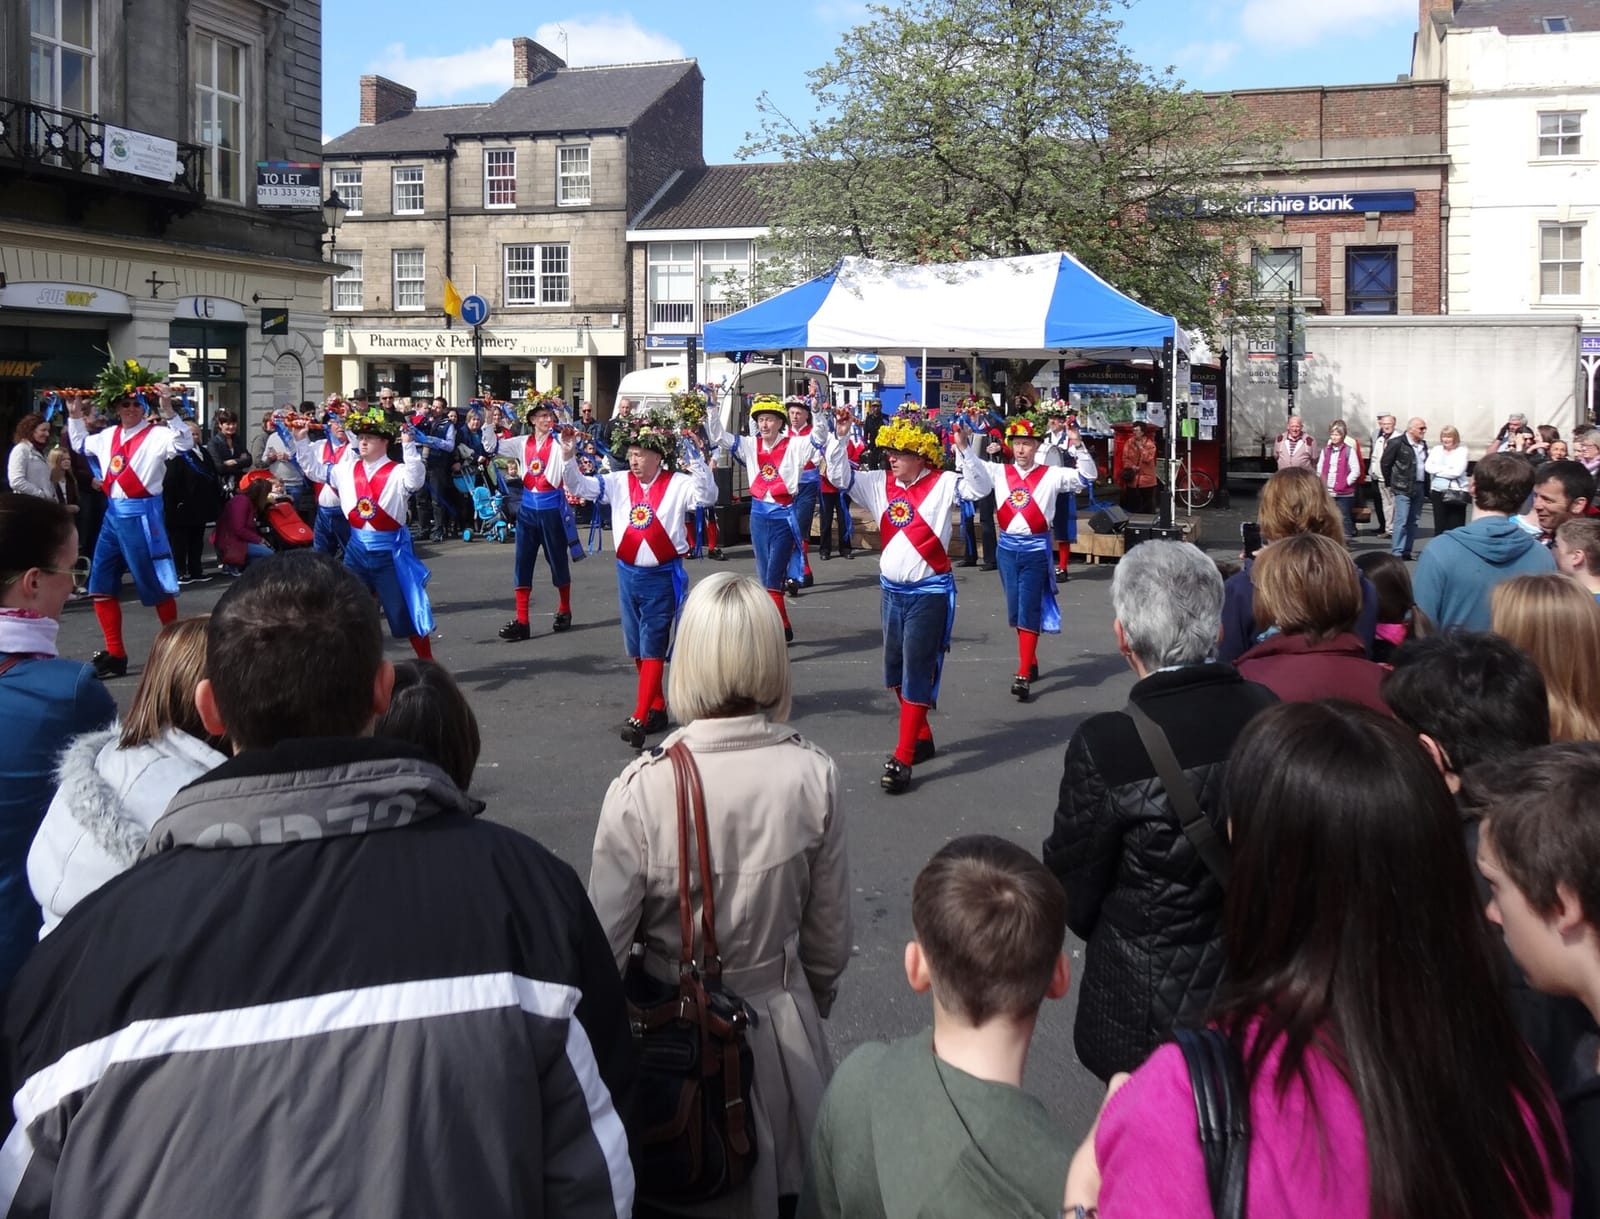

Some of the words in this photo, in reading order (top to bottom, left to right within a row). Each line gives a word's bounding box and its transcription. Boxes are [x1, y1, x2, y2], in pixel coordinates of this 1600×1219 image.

[263, 173, 279, 185] TO
[282, 173, 302, 185] LET
[257, 187, 279, 196] 0113
[281, 188, 298, 197] 333
[1308, 195, 1355, 212] Bank
[36, 287, 98, 306] SUBWAY
[369, 333, 432, 351] Pharmacy
[435, 334, 446, 348] &
